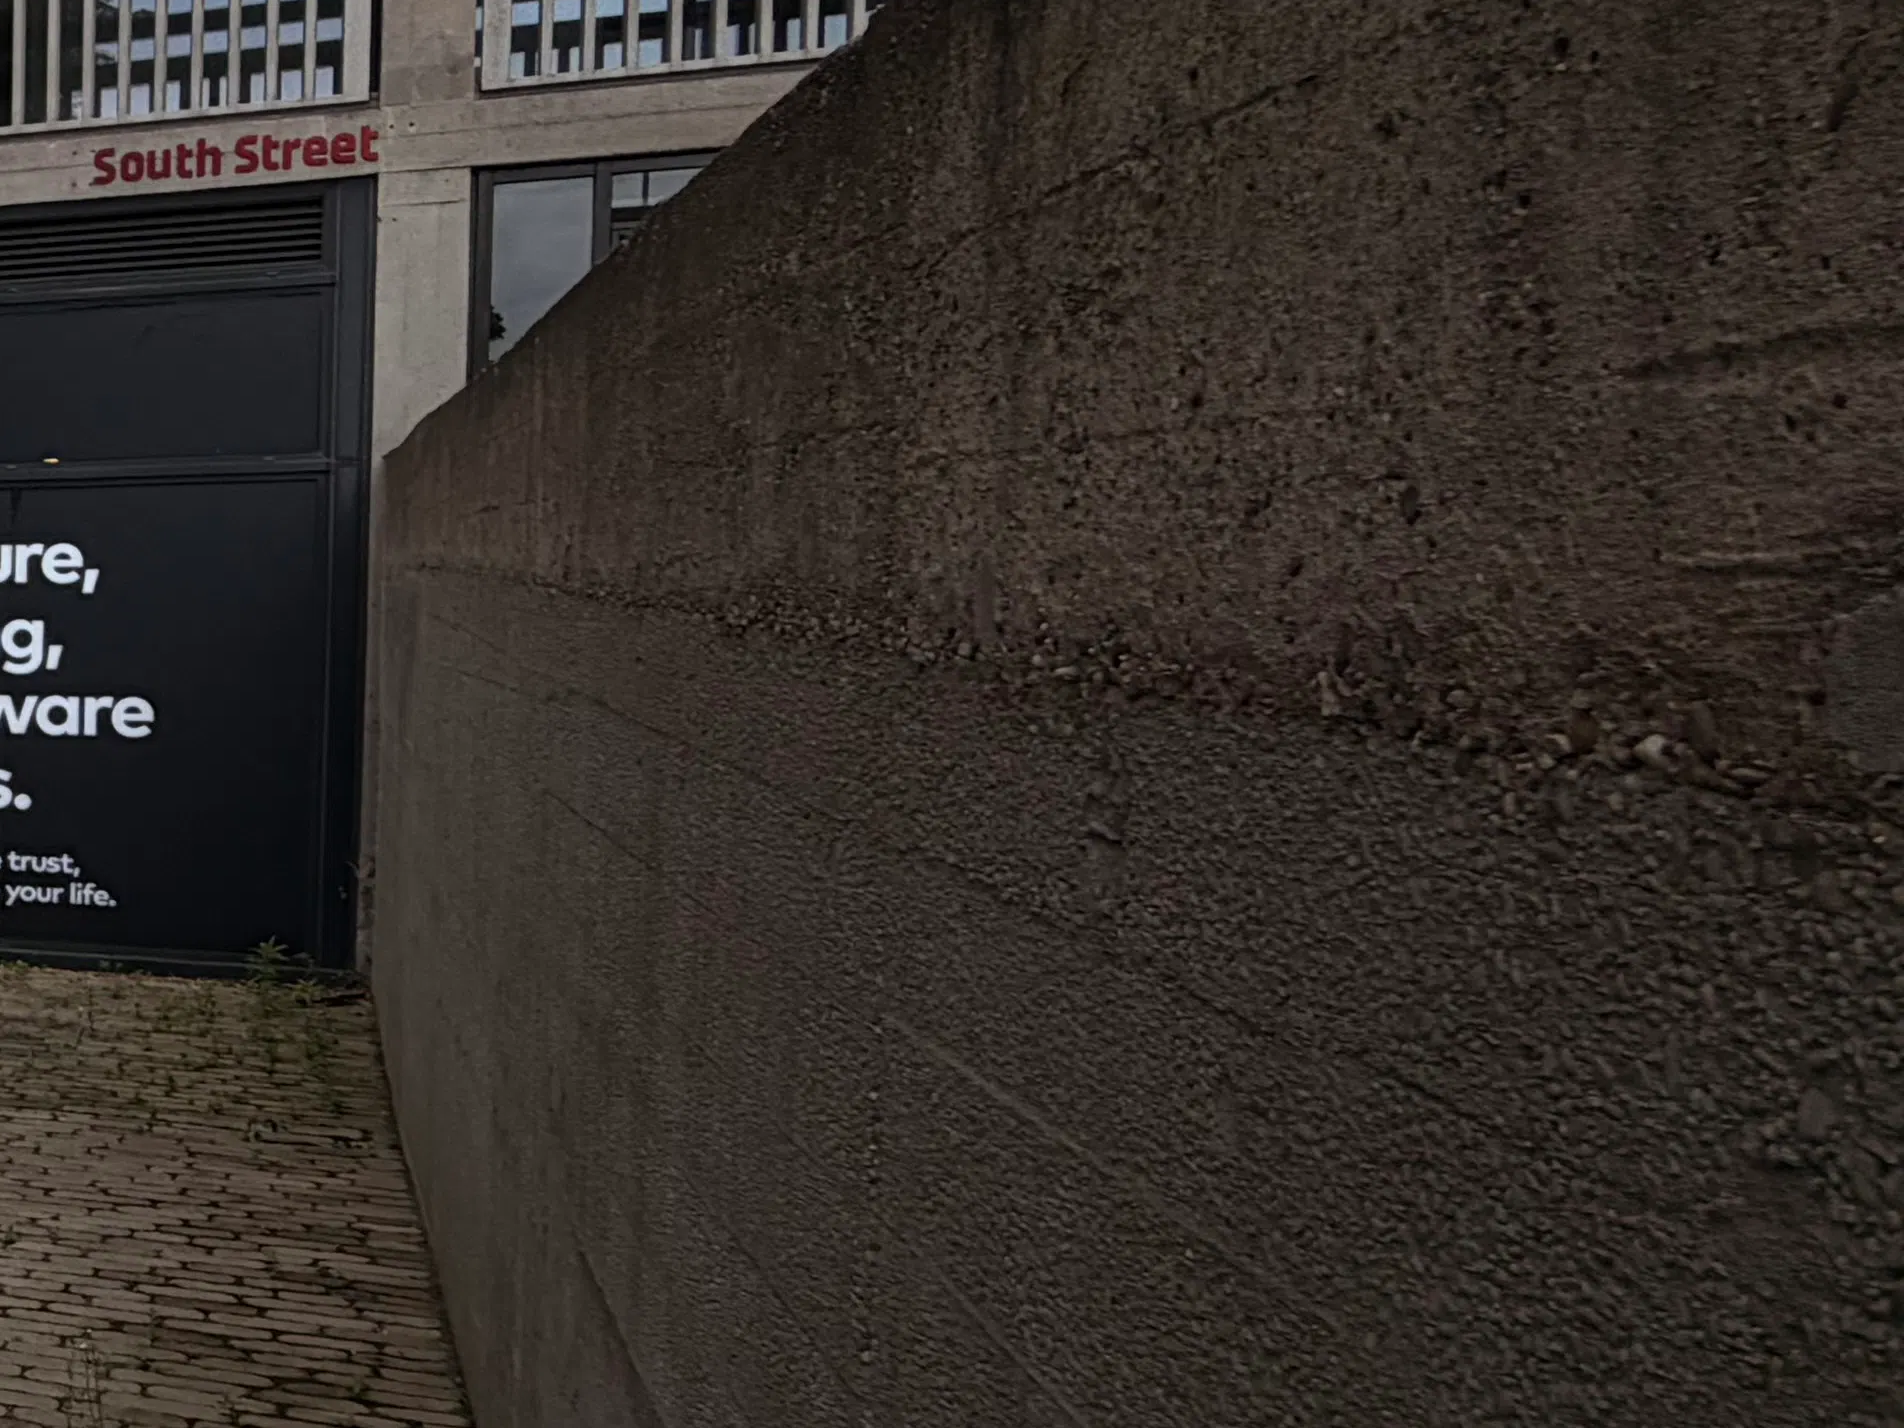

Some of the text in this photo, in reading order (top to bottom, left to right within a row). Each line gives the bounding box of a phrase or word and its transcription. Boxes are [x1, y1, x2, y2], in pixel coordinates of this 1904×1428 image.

[93, 125, 381, 186] South Street
[6, 850, 81, 878] trust,
[5, 884, 65, 907] your
[68, 881, 117, 907] life.
